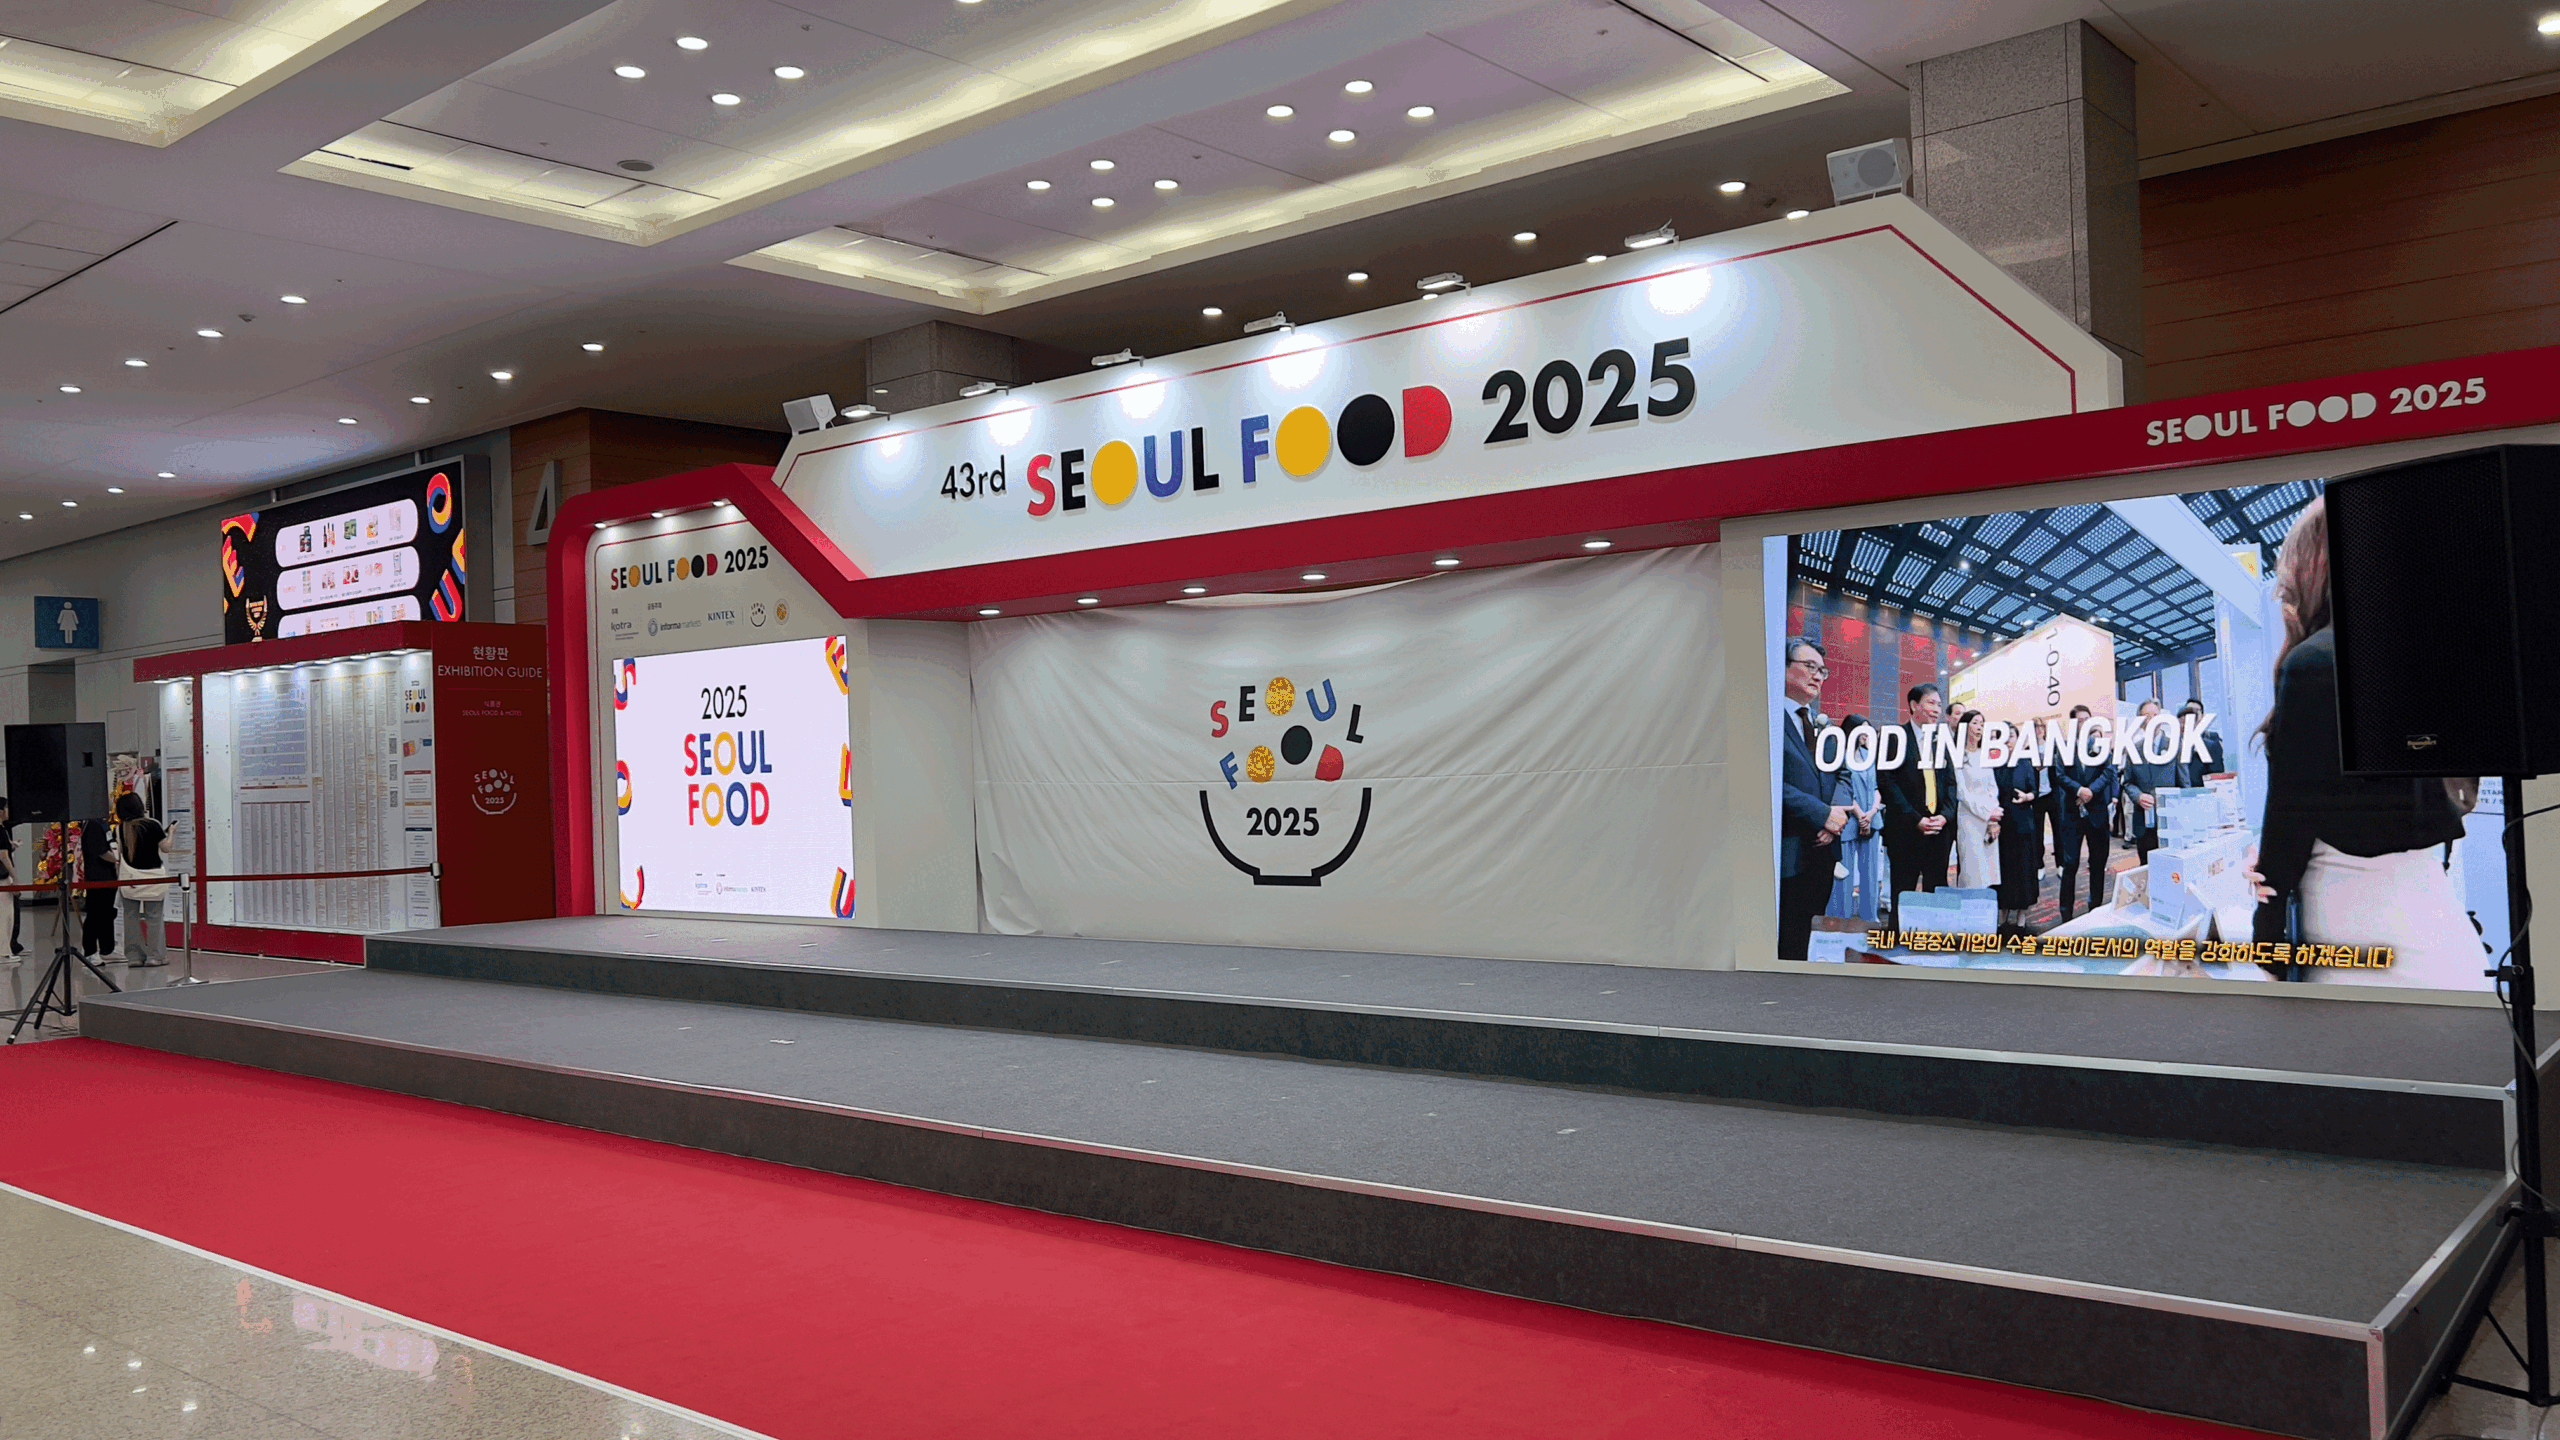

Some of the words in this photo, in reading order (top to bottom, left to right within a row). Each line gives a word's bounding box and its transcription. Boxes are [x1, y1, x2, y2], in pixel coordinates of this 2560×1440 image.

[940, 454, 1008, 500] 43rd
[1026, 426, 1220, 518] SEOUL
[1239, 383, 1453, 486] FOOD
[1482, 336, 1697, 445] 2025
[2146, 408, 2258, 446] SEOUL
[2268, 392, 2377, 430] FOOD
[2388, 376, 2487, 414] 2025
[611, 562, 662, 590] SEOUL
[668, 553, 718, 582] FOOD
[724, 545, 769, 574] 2025
[610, 621, 632, 632] kotra
[707, 610, 735, 621] KINTEX
[437, 665, 504, 678] EXHIBITION
[506, 667, 543, 678] GUIDE
[472, 646, 509, 661] 현황판
[405, 689, 426, 701] SEOUL
[701, 685, 748, 720] 2025
[1210, 676, 1364, 744] SEOUL
[684, 730, 772, 776] SEOUL
[1219, 725, 1344, 790] FOOD
[1814, 723, 1908, 773] OOD
[1916, 721, 1969, 769] IN
[1978, 712, 2218, 768] BANGKOK
[485, 796, 504, 804] 2025
[688, 782, 769, 826] FOOD
[1246, 807, 1320, 837] 2025
[1866, 929, 1895, 950] 국내
[1899, 930, 2002, 954] 식품중소기업의
[2006, 934, 2038, 955] 수출
[2042, 935, 2139, 958] 길잡이로서의
[2144, 938, 2197, 961] 역할을
[2200, 940, 2292, 965] 강화하도록
[2295, 943, 2394, 969] 하겠습니다
